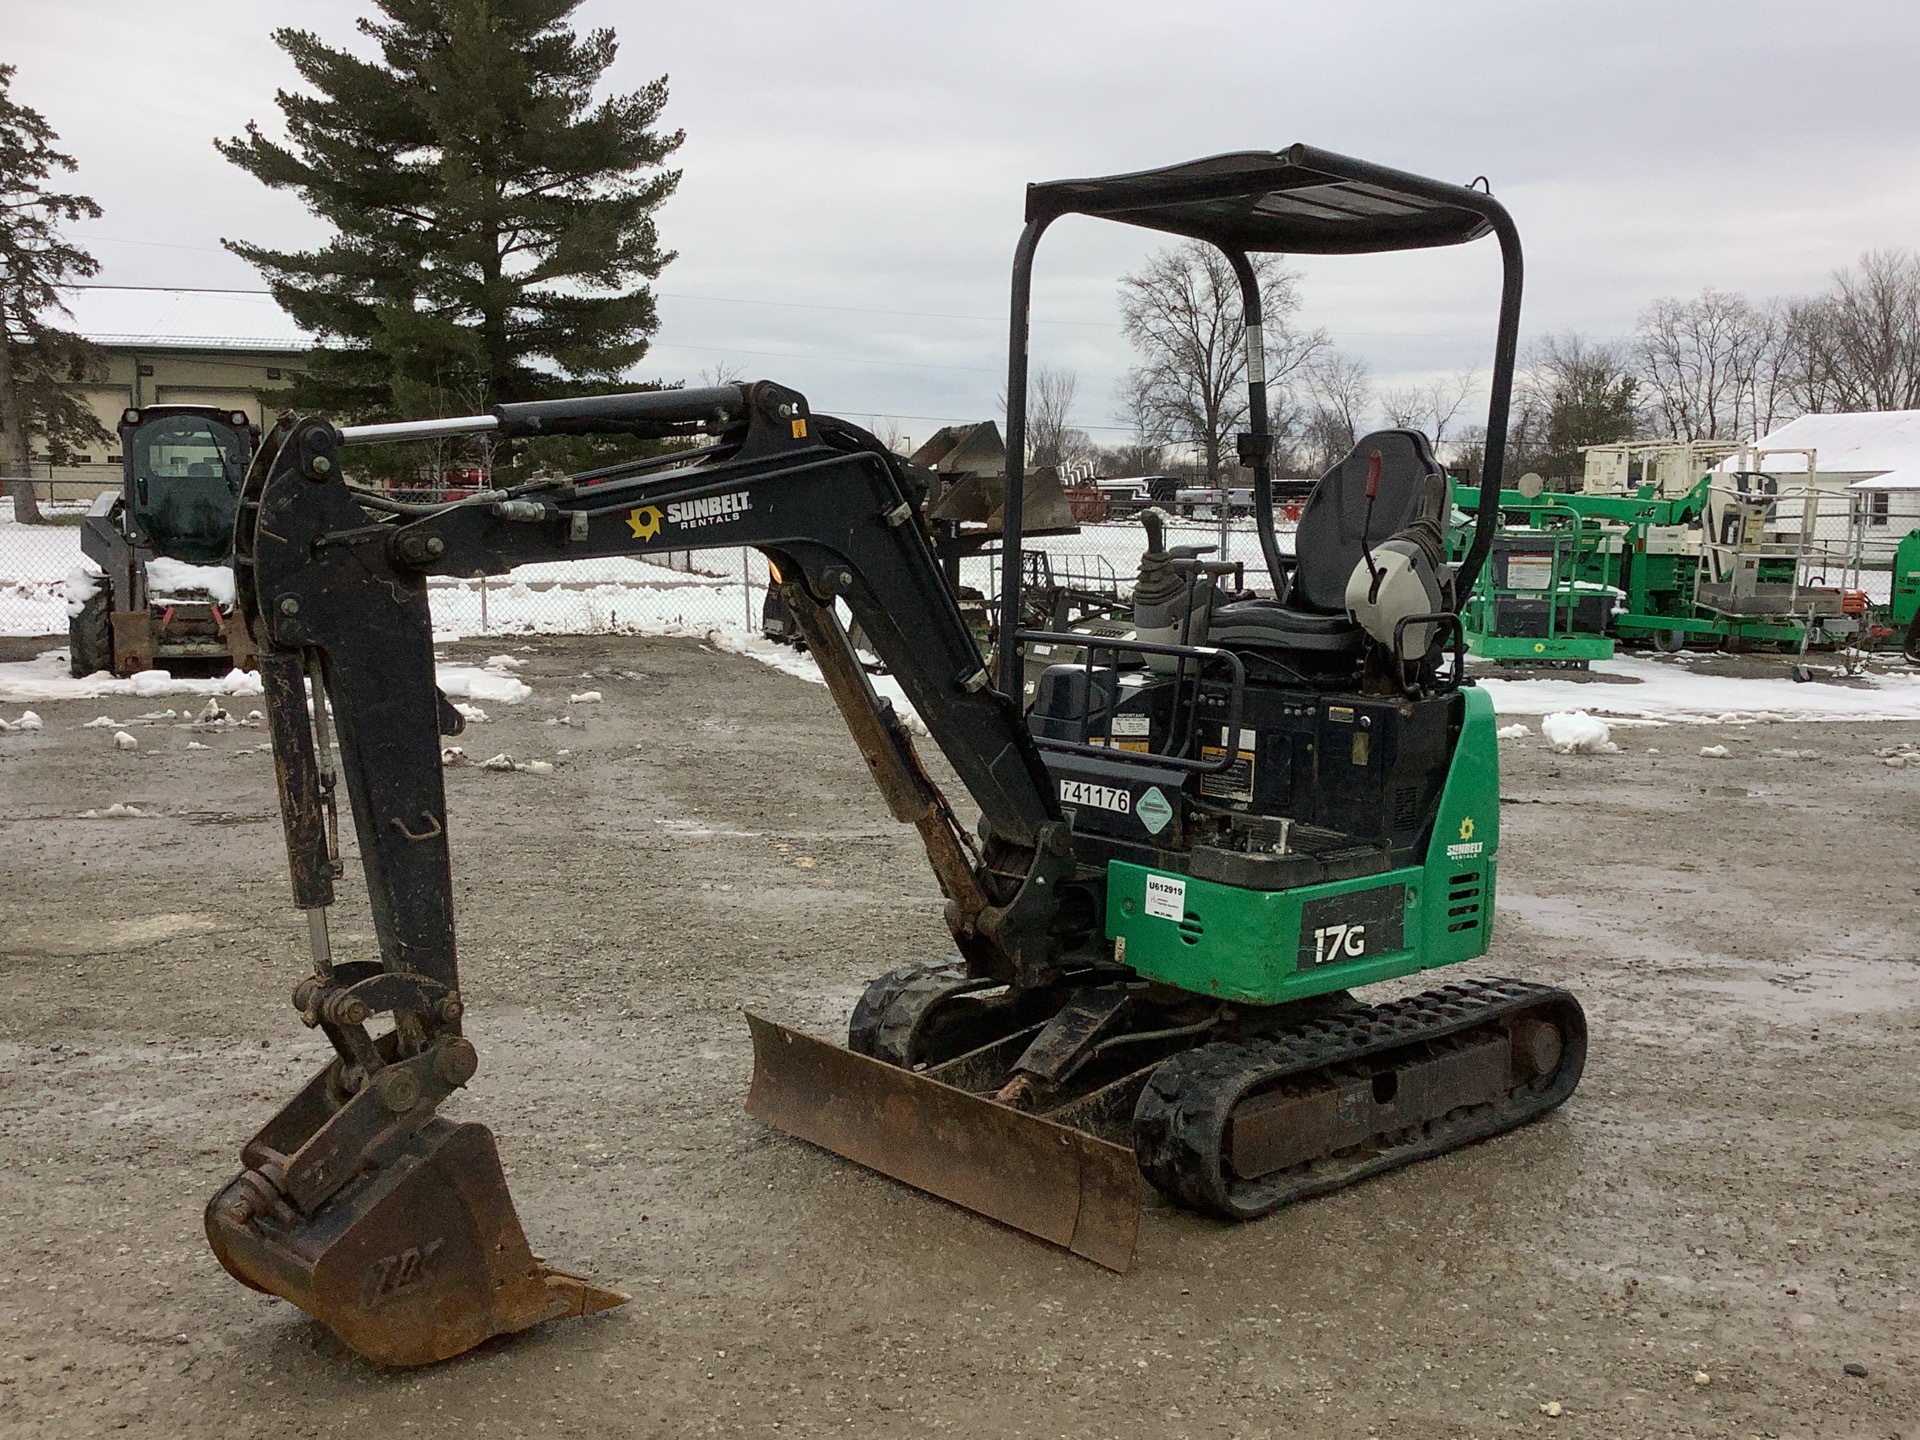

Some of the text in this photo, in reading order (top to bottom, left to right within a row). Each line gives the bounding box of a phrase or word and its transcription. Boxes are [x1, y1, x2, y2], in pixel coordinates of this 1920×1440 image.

[667, 491, 750, 523] SUNBELT
[680, 512, 740, 530] RENTALS
[1064, 781, 1128, 811] 741176
[1446, 842, 1483, 856] SUNBELT
[1149, 881, 1183, 896] U612919
[1314, 924, 1365, 963] 17G
